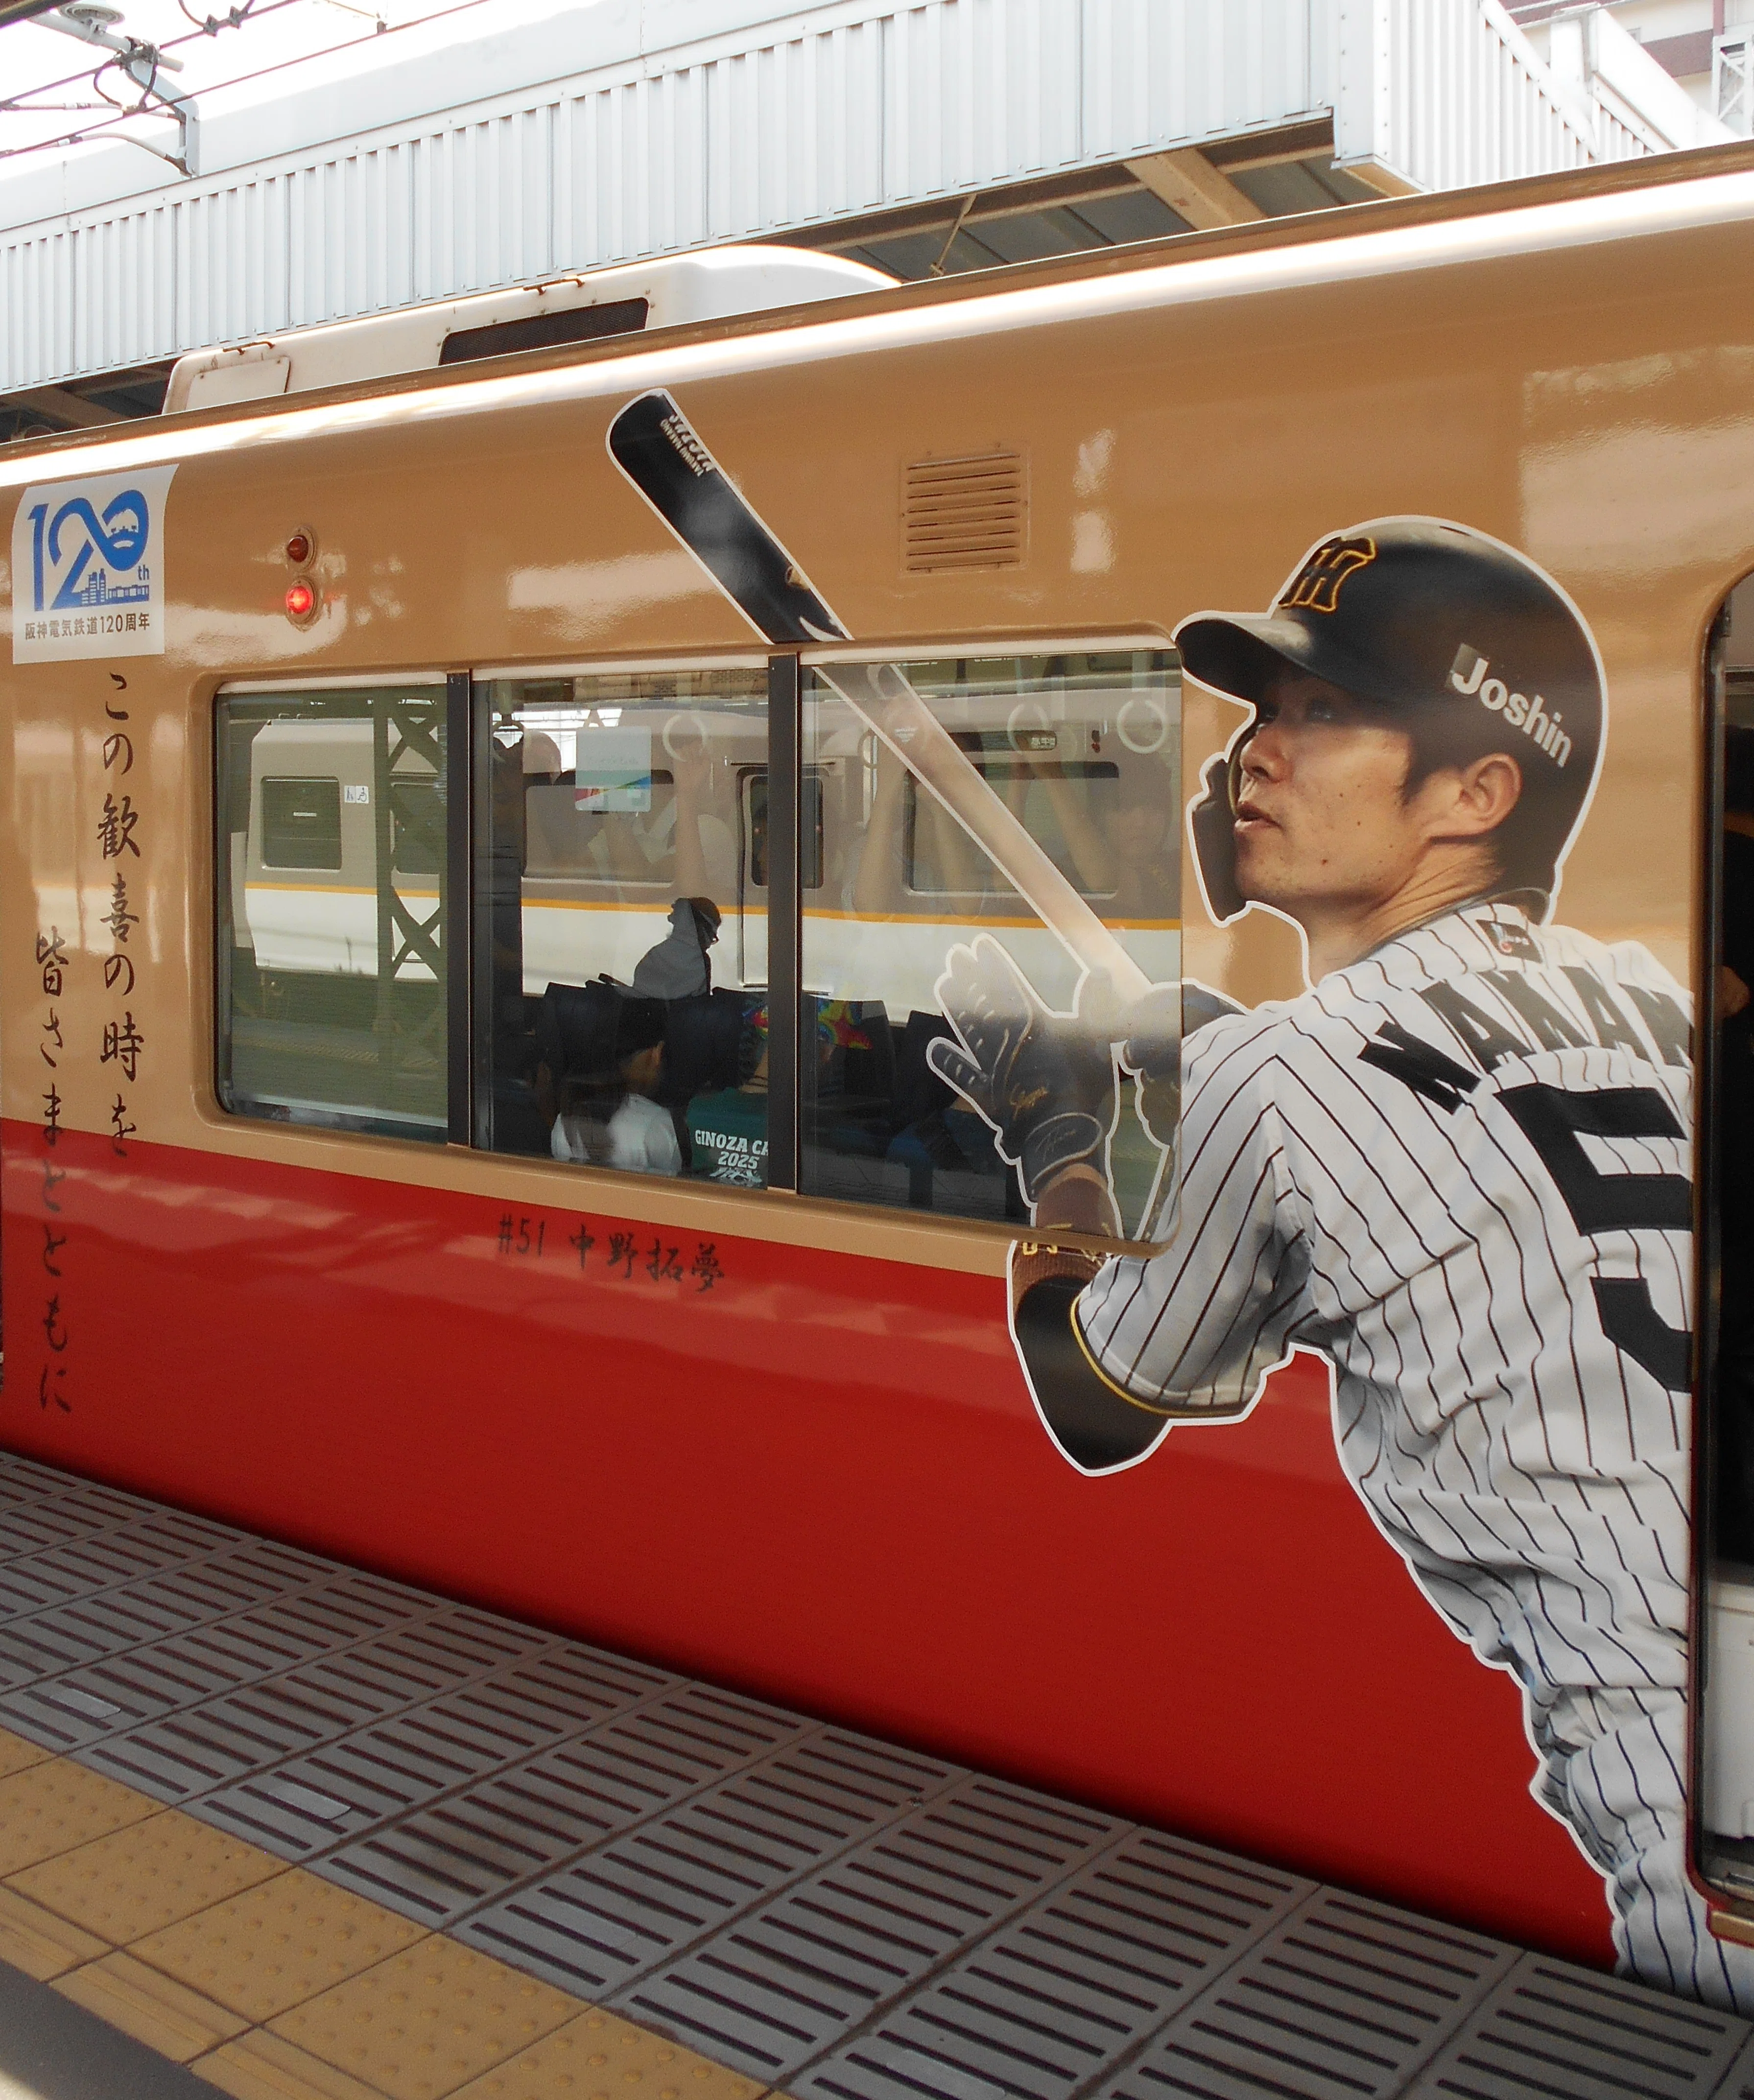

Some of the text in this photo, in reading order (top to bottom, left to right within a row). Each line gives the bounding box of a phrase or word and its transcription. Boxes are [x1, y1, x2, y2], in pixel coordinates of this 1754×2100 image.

[25, 612, 150, 640] 阪神電気鉄道120周年
[1451, 657, 1571, 768] Joshin
[97, 672, 144, 1157] この歓喜の時を
[36, 926, 71, 1414] 皆さまとともに
[695, 1130, 747, 1153] GINOZA
[718, 1151, 759, 1169] 2025
[498, 1214, 725, 1293] #51 中野拓夢
